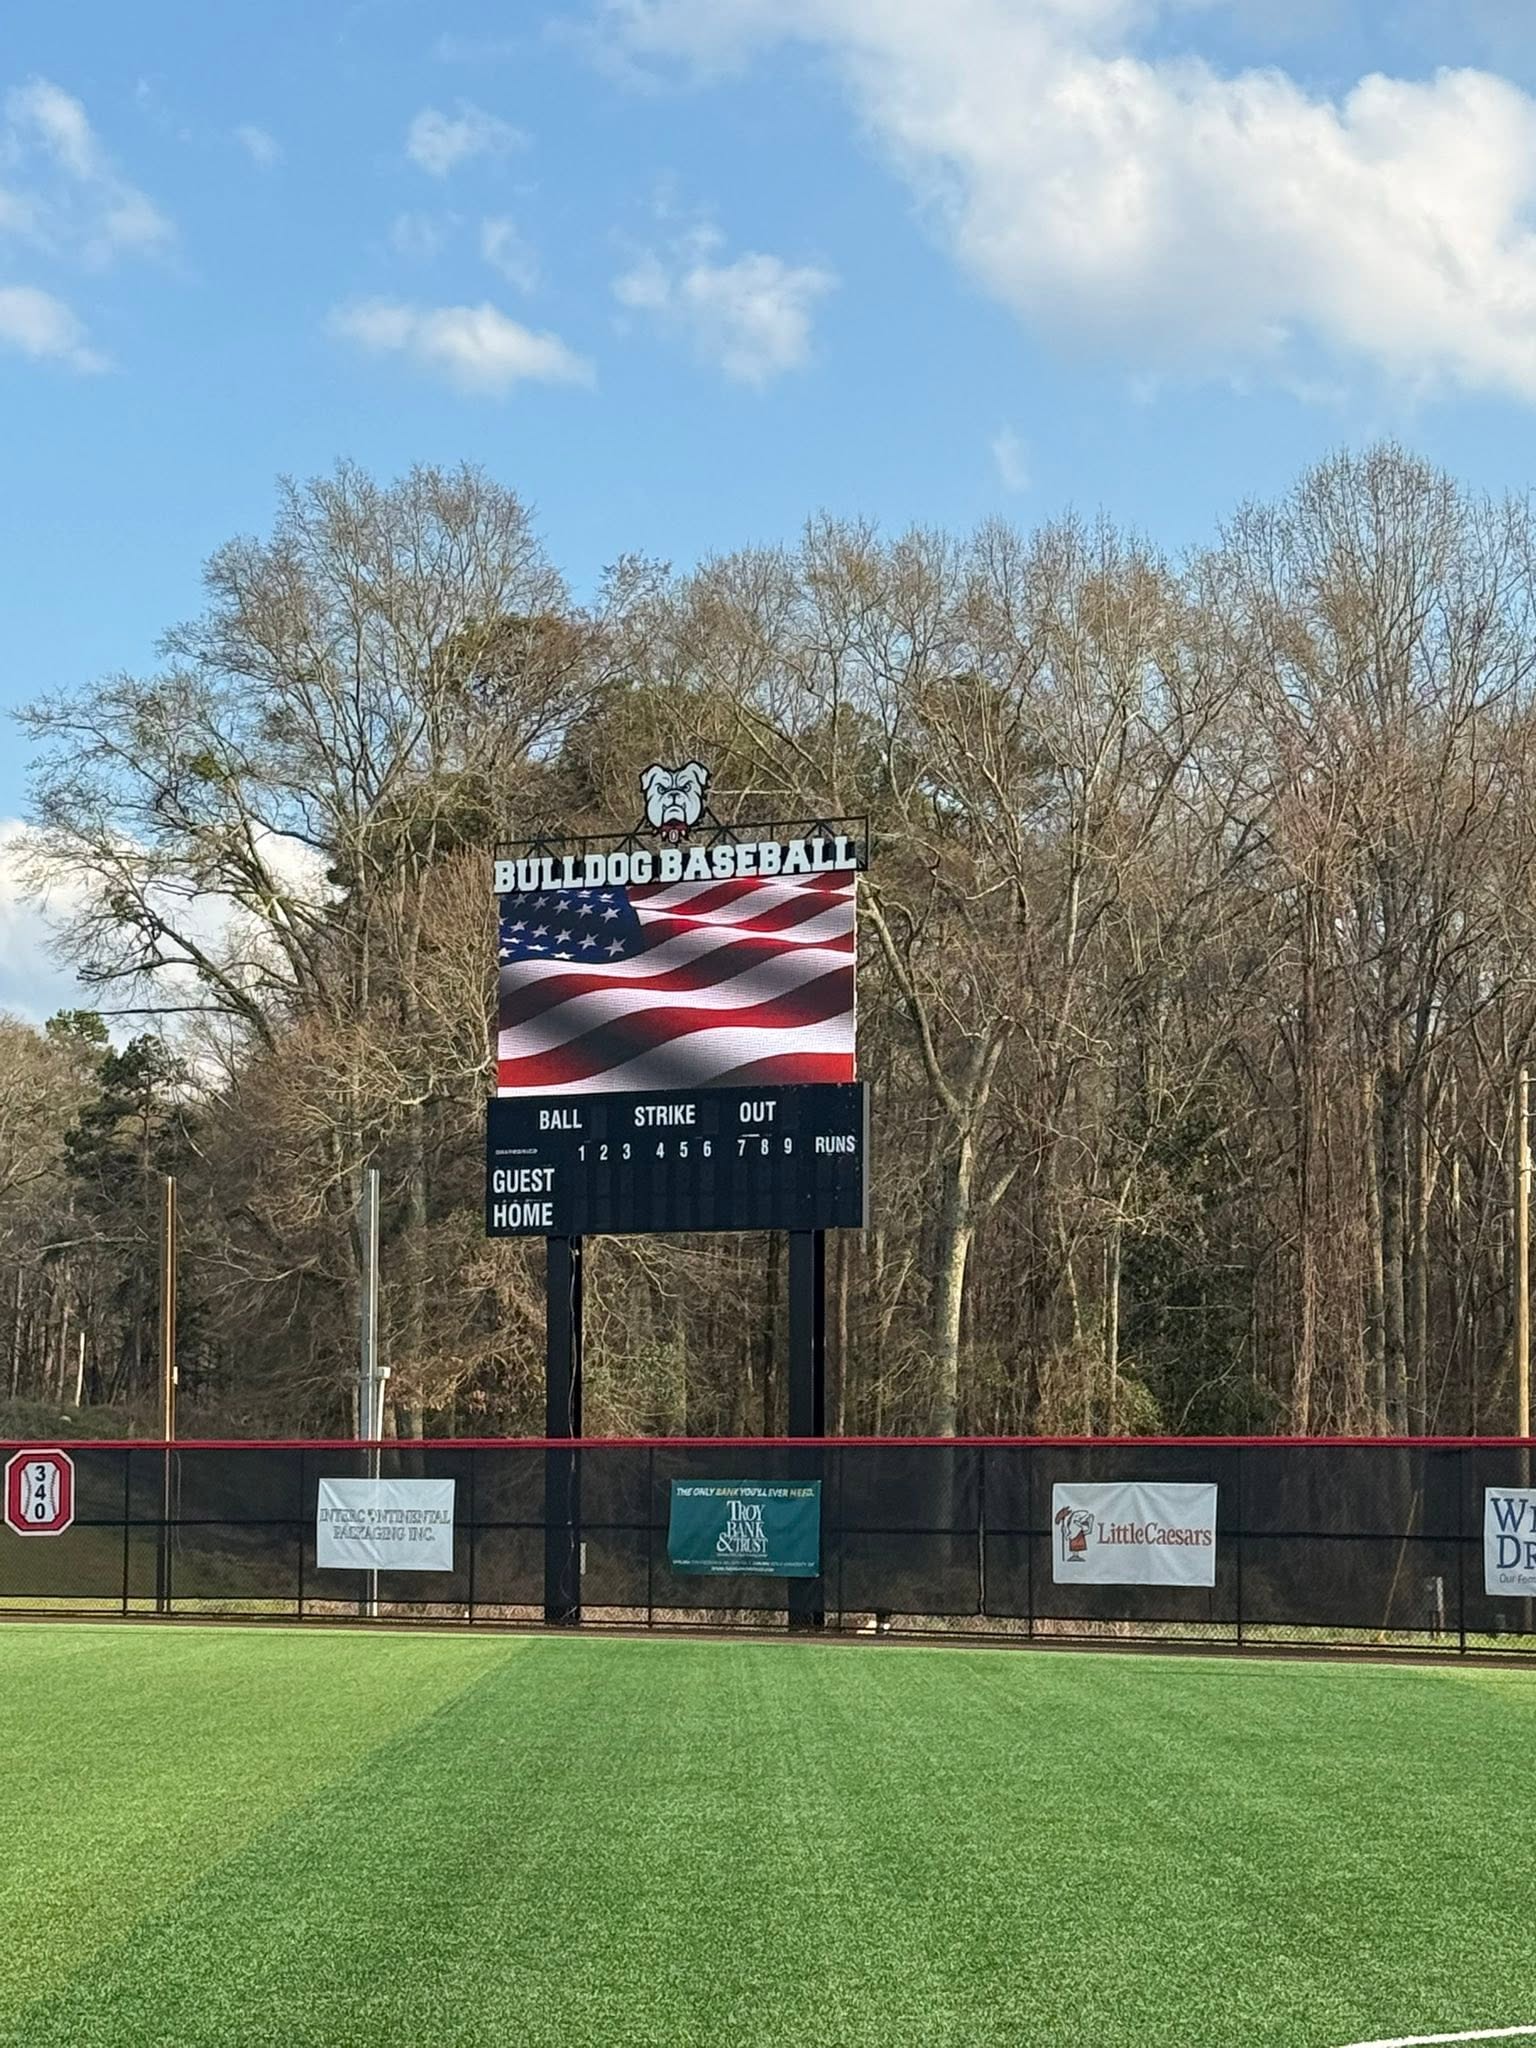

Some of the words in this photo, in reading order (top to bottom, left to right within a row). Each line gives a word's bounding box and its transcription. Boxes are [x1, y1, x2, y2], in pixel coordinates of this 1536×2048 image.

[494, 850, 652, 893] BULLDOG
[659, 836, 857, 882] BASEBALL
[539, 1109, 583, 1130] BALL
[634, 1104, 696, 1126] STRIKE
[739, 1101, 777, 1123] OUT
[578, 1145, 585, 1161] 1
[600, 1144, 608, 1160] 2
[622, 1143, 631, 1159] 3
[656, 1142, 665, 1159] 4
[679, 1141, 688, 1158] 5
[703, 1140, 712, 1157] 6
[737, 1139, 746, 1156] 7
[760, 1138, 769, 1155] 8
[784, 1137, 793, 1154] 9
[815, 1136, 856, 1153] RUNS
[493, 1168, 555, 1194] GUEST
[493, 1203, 553, 1227] HOME
[676, 1487, 693, 1496] THE
[693, 1487, 714, 1497] ONLY
[715, 1487, 739, 1497] BANK
[768, 1487, 789, 1497] EVER
[726, 1500, 766, 1521] TROY
[333, 1525, 406, 1541] PACKAGING
[408, 1527, 436, 1541] INC.
[727, 1521, 766, 1538] BANK
